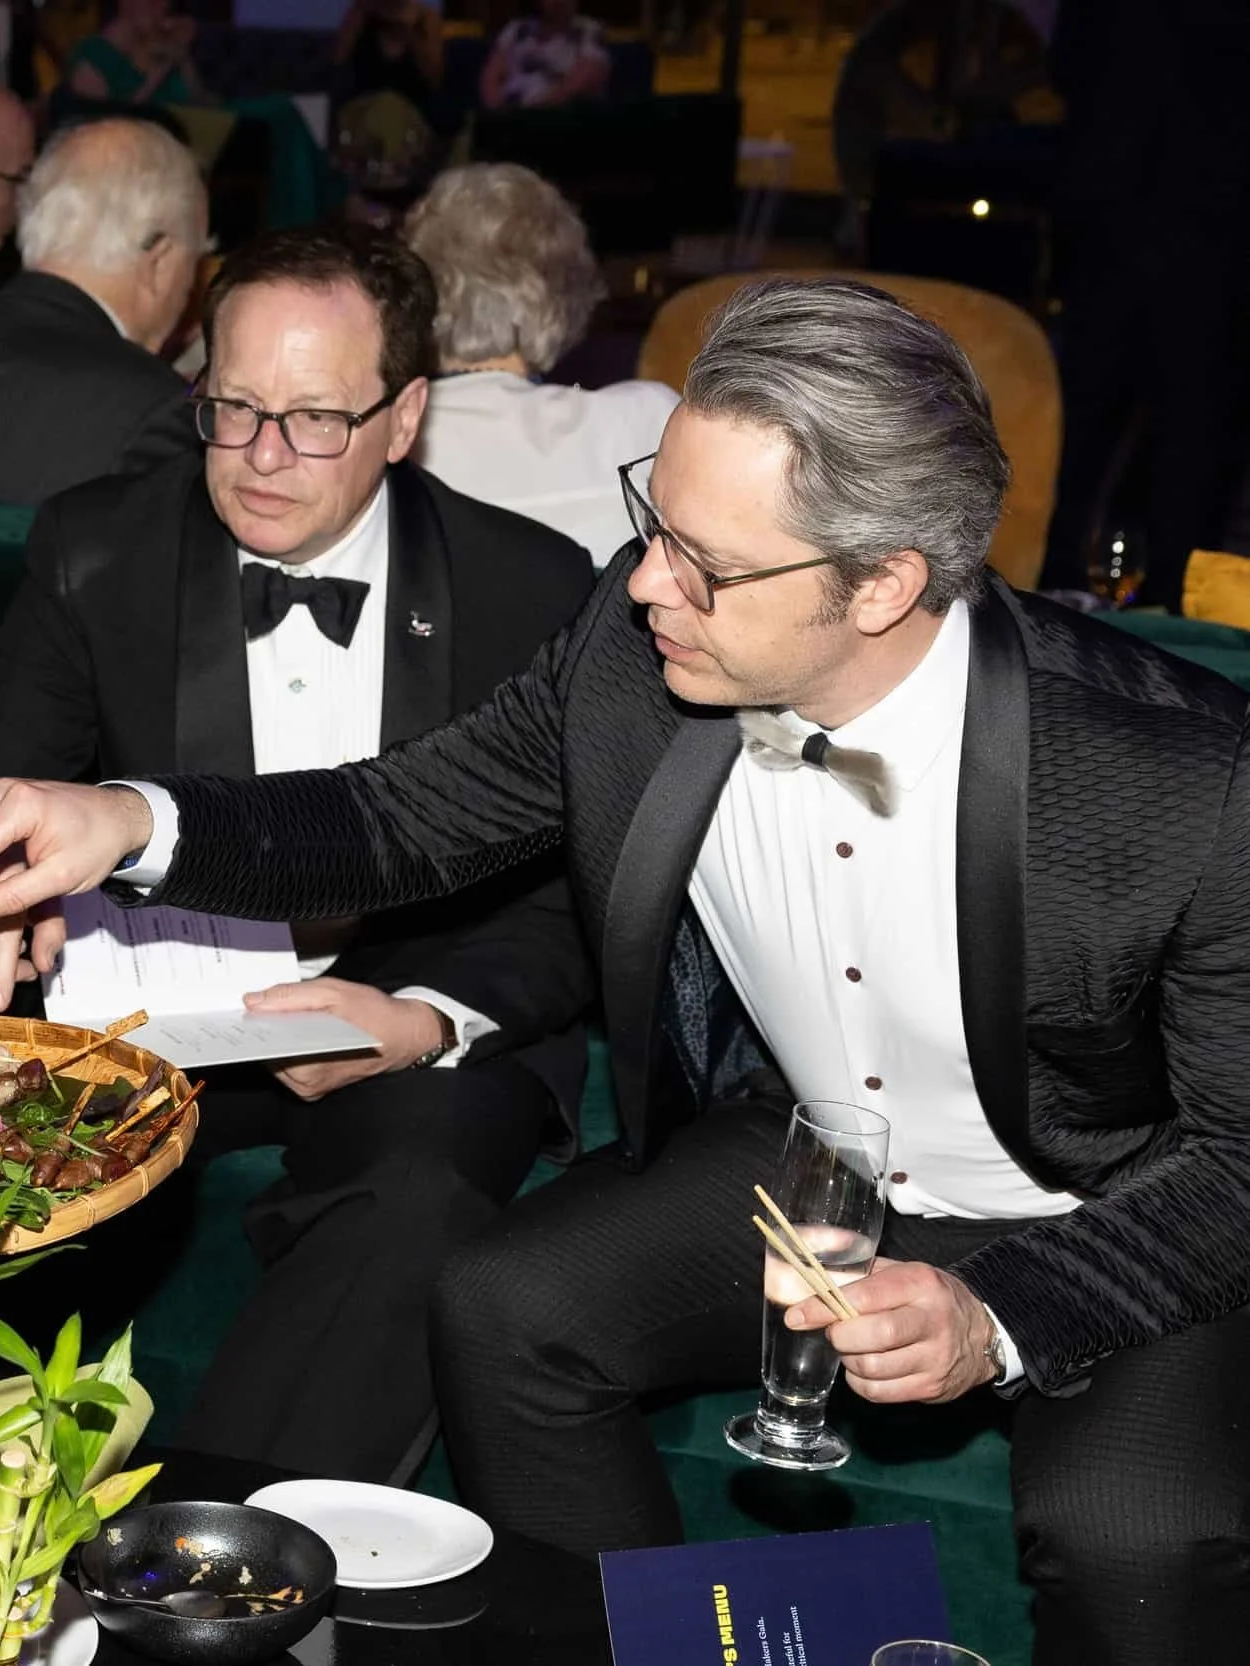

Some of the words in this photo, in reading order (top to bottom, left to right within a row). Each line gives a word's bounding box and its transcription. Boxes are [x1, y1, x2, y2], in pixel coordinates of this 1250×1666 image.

[713, 1584, 735, 1645] MENU
[790, 1605, 803, 1642] moment
[782, 1632, 791, 1644] for
